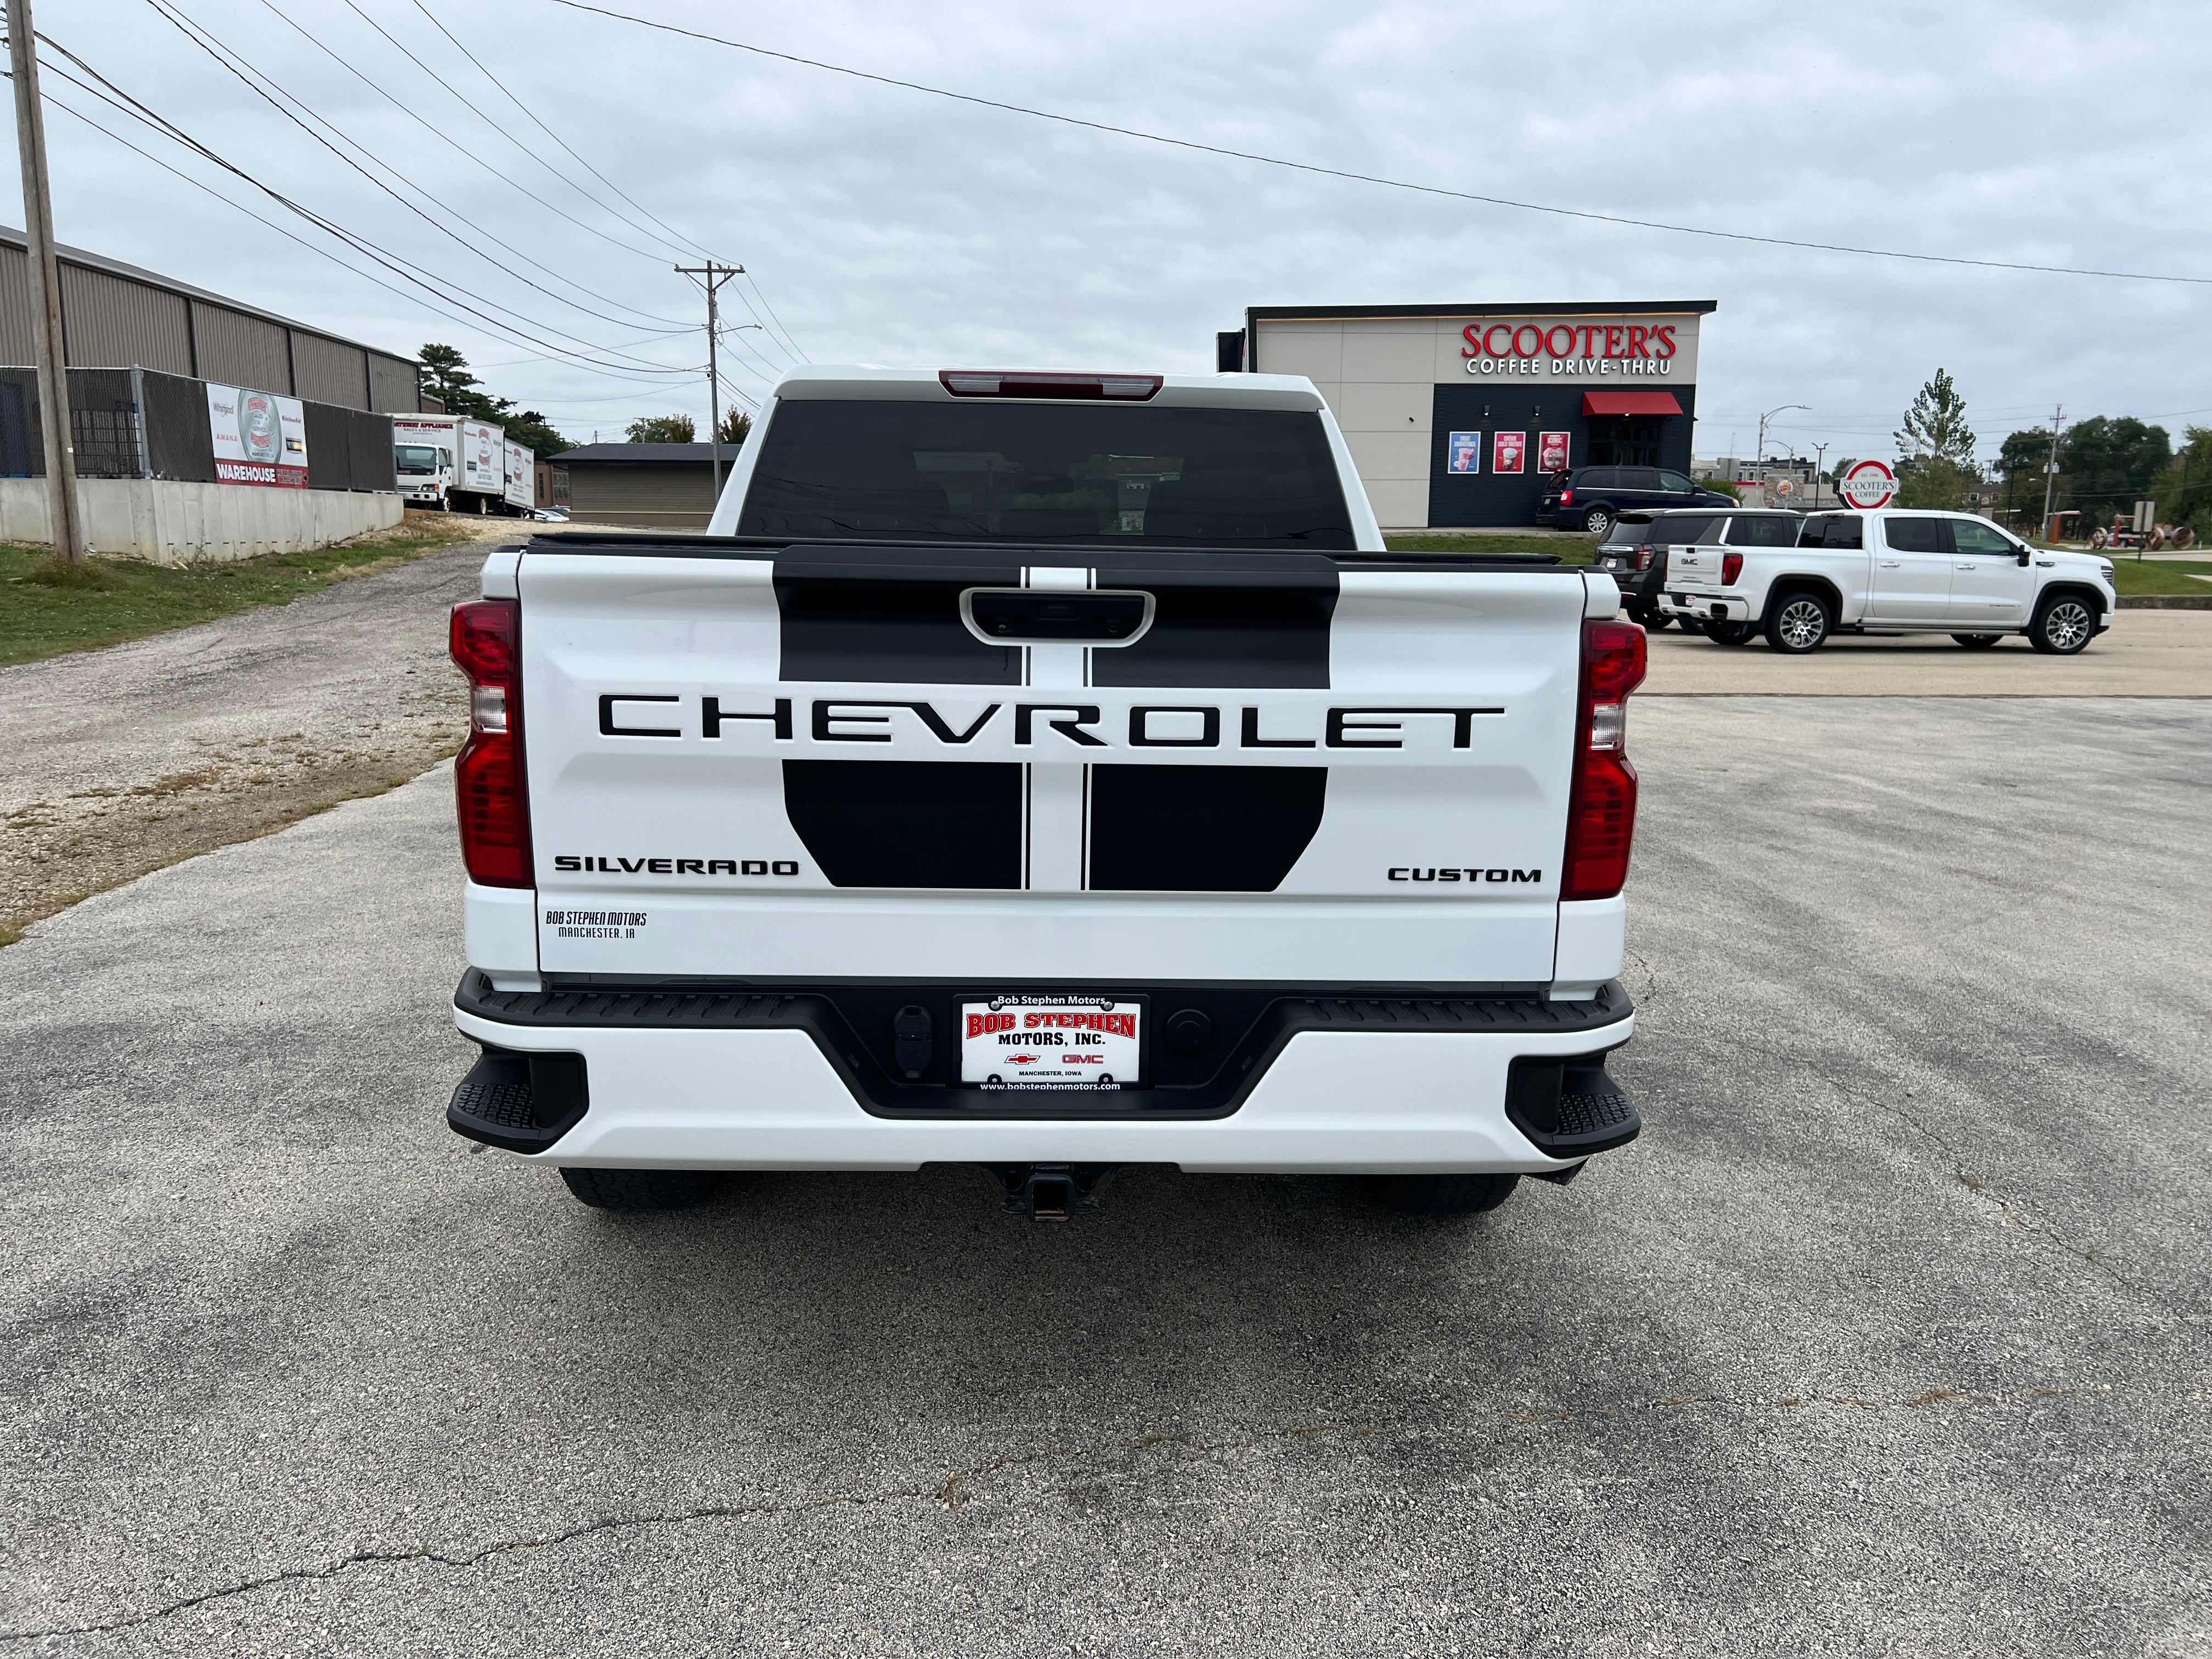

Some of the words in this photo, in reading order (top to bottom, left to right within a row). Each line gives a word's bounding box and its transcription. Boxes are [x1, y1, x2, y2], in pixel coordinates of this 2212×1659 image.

[1462, 324, 1677, 359] SCOOTER'S
[1466, 358, 1541, 374] COFFEE
[1551, 359, 1672, 375] DRIVE-THRU
[216, 433, 238, 442] AMANA
[216, 463, 276, 483] WAREHOUSE
[1843, 481, 1894, 490] SCOOTER'S
[599, 695, 1506, 749] CHEVROLET
[555, 855, 799, 876] SILVERADO
[1387, 867, 1542, 882] CUSTOM
[546, 911, 565, 925] BOB
[566, 911, 606, 926] STEPHEN
[607, 912, 647, 927] MOTORS
[625, 928, 635, 939] IA
[997, 996, 1019, 1005] Bob
[1021, 996, 1065, 1006] Stephen
[1068, 996, 1106, 1005] Motors
[966, 1013, 1016, 1039] BOB
[1024, 1013, 1136, 1039] STEPHEN
[998, 1032, 1068, 1047] MOTORS,
[1075, 1032, 1106, 1045] INC.
[1062, 1054, 1104, 1064] GMC
